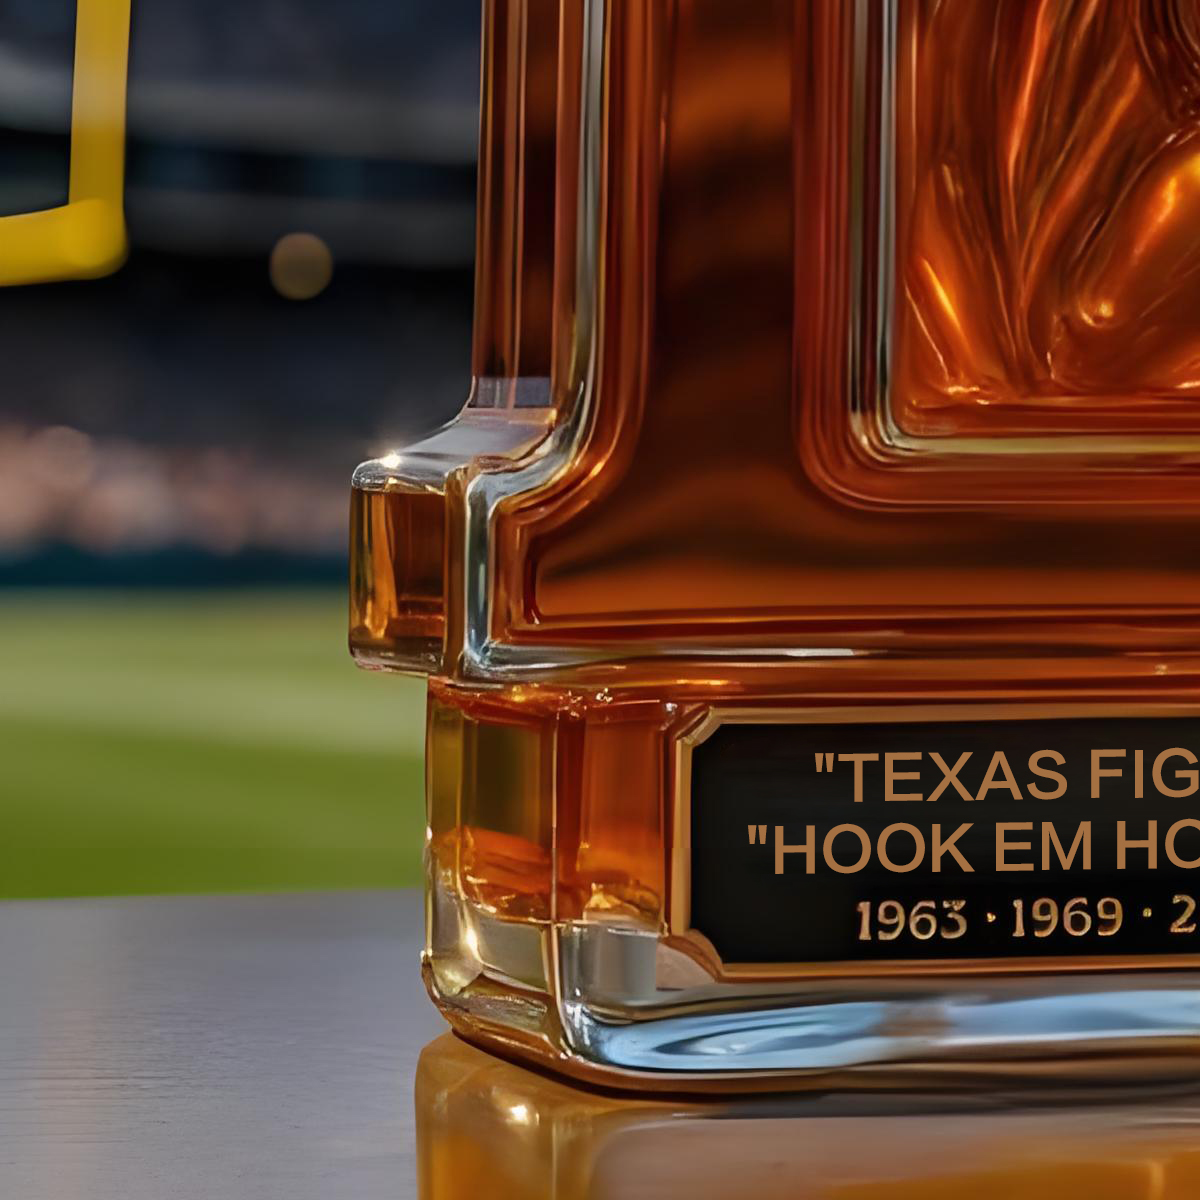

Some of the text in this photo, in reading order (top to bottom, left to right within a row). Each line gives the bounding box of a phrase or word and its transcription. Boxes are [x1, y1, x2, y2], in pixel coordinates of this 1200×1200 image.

[814, 749, 1068, 803] "TEXAS
[747, 822, 976, 875] "HOOK
[995, 820, 1092, 872] EM
[857, 899, 967, 941] 1963
[1012, 896, 1123, 938] 1969
